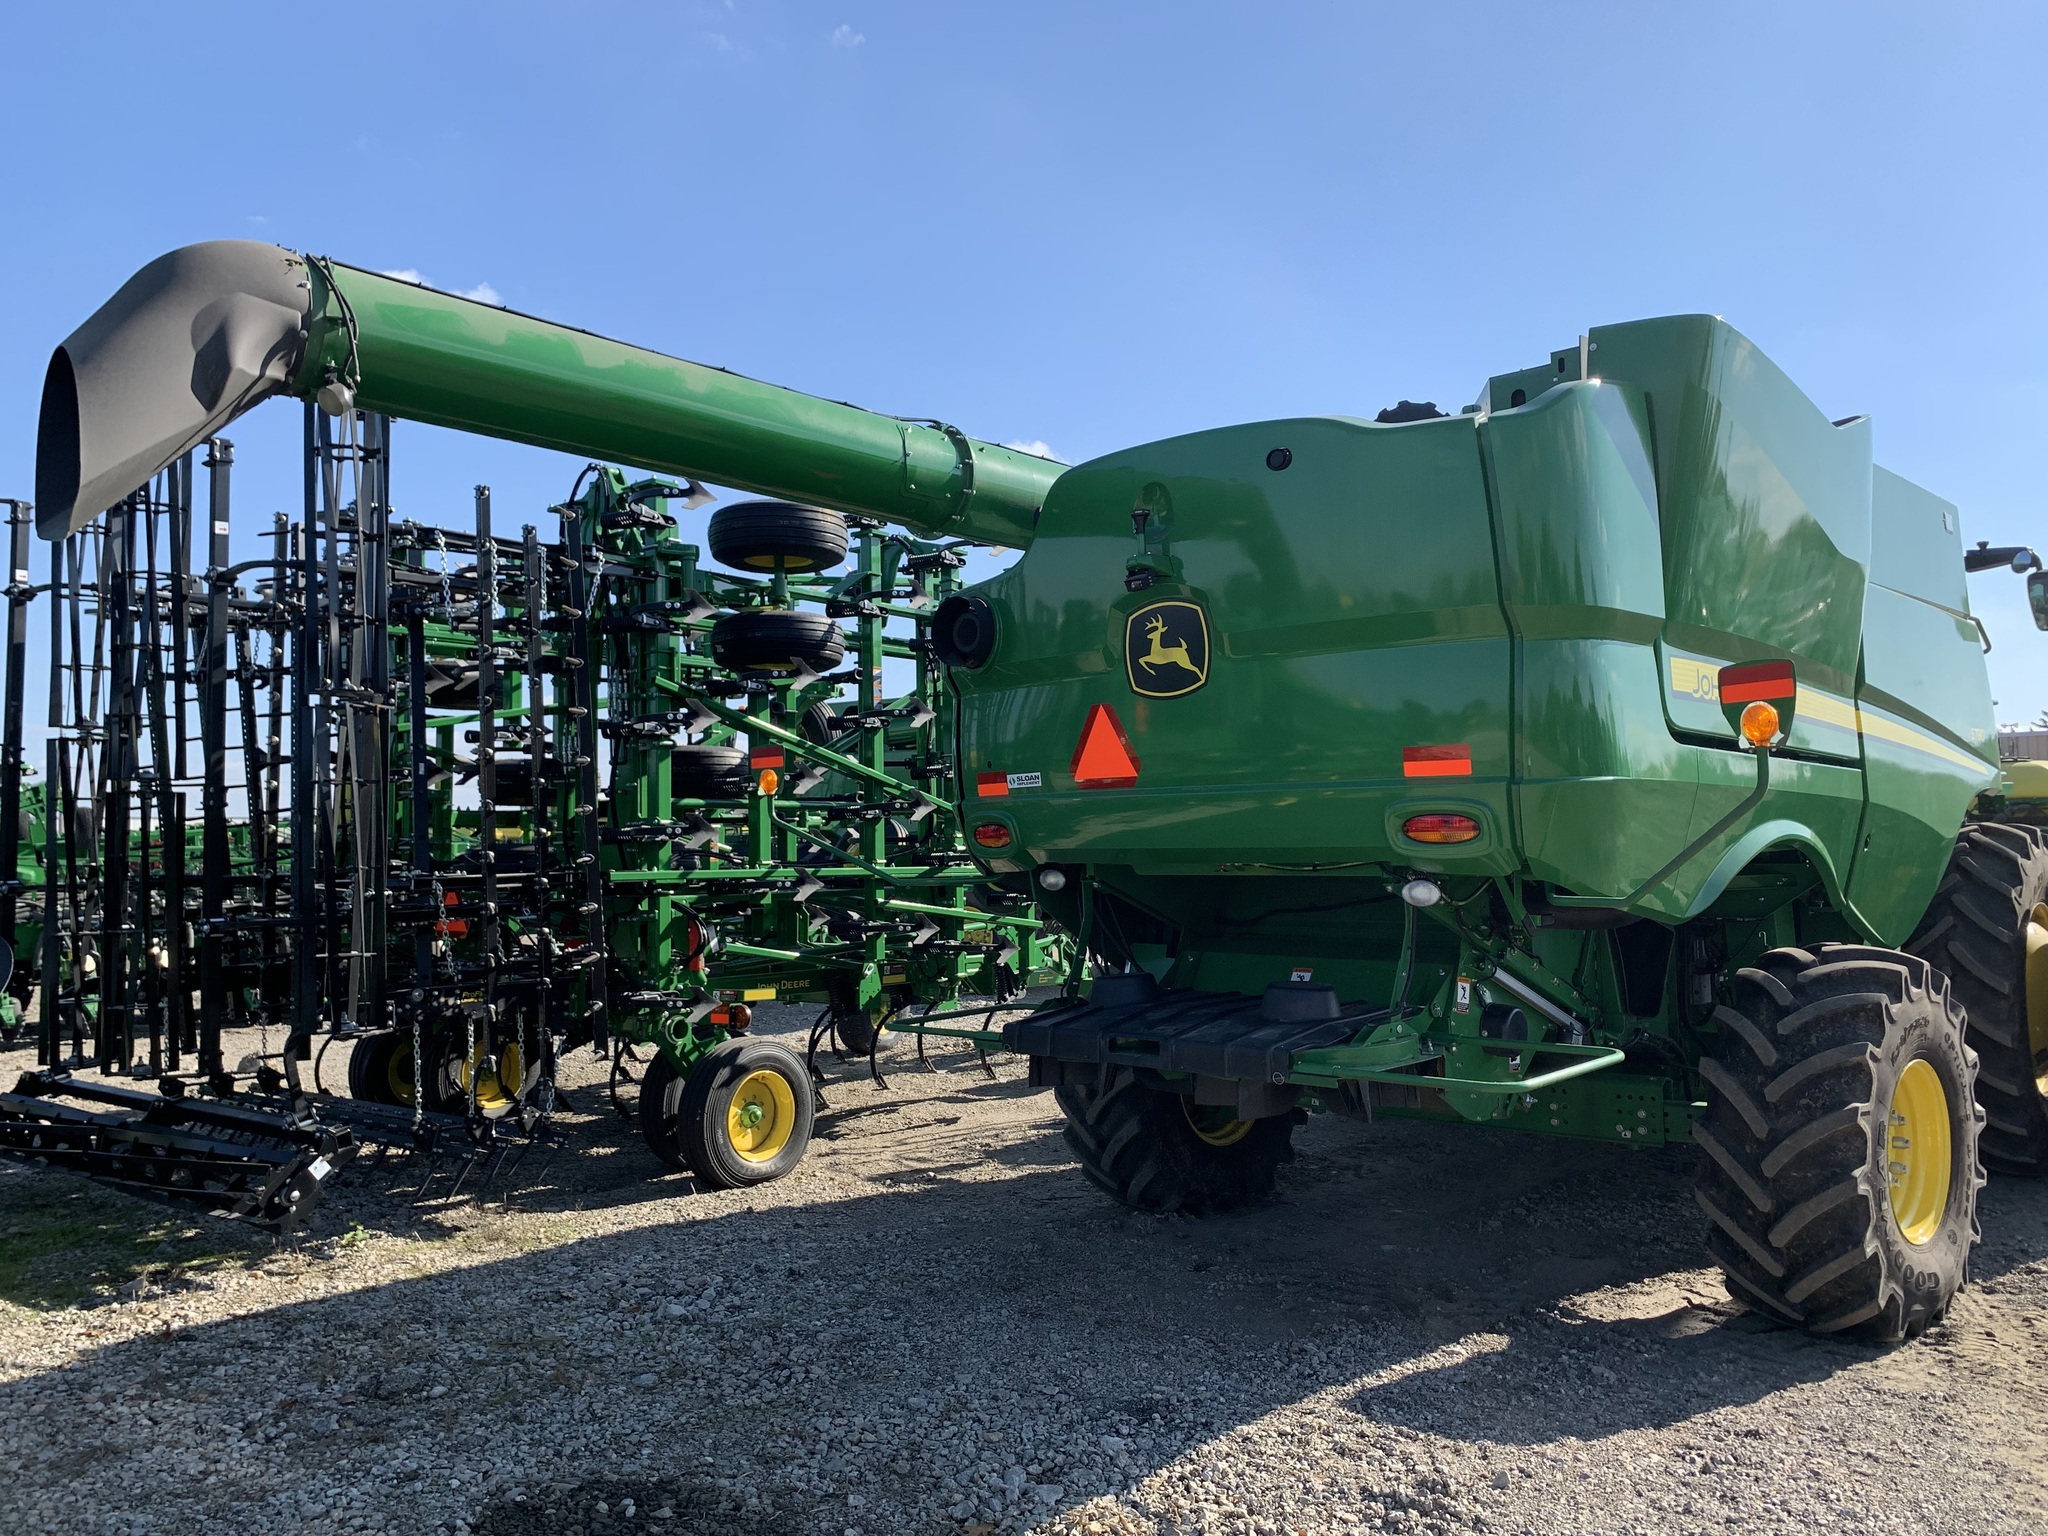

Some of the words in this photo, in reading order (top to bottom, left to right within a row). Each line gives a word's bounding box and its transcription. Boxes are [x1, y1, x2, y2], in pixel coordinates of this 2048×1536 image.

[1692, 668, 1719, 699] JOH
[1016, 774, 1040, 782] SLOAN
[781, 979, 811, 990] DEERE
